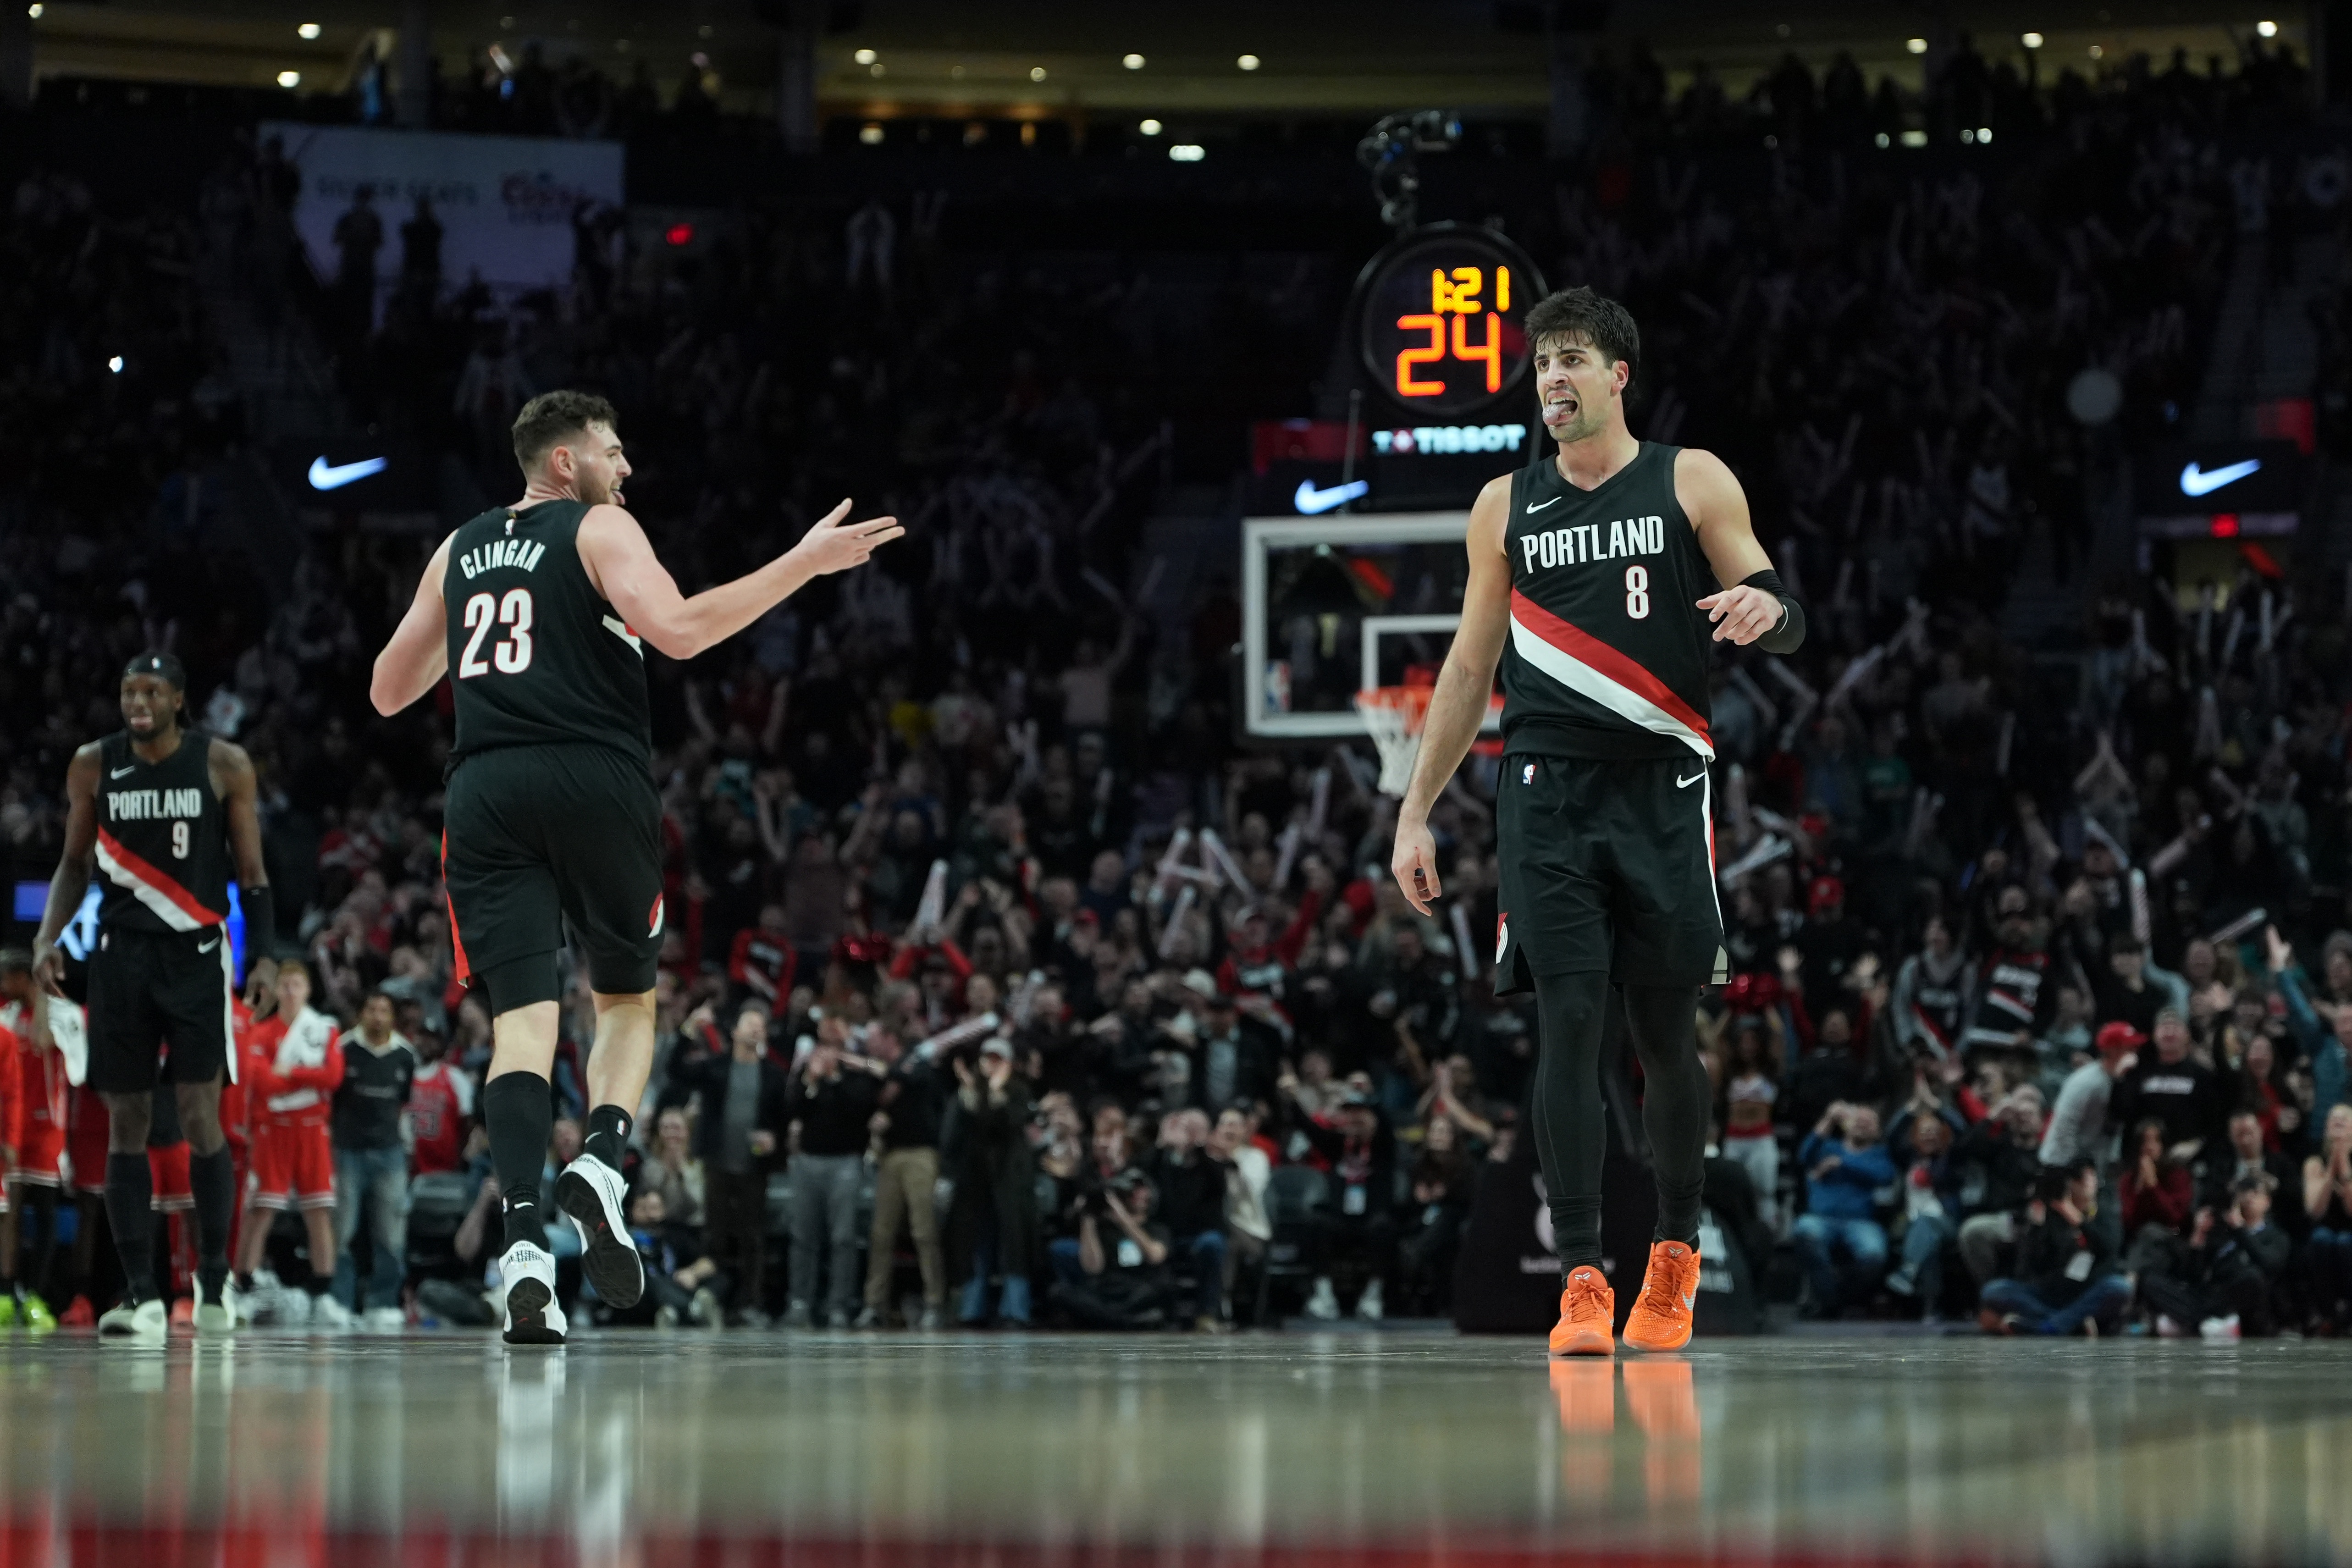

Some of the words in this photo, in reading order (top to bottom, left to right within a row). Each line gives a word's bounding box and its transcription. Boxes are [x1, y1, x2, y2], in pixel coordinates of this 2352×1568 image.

[1432, 266, 1509, 314] 1:21
[1397, 312, 1501, 396] 24
[459, 539, 546, 580] CLINGAN
[1519, 515, 1665, 574] PORTLAND
[1625, 564, 1650, 619] 8
[459, 587, 533, 679] 23
[106, 787, 203, 822] PORTLAND
[171, 821, 190, 860] 9
